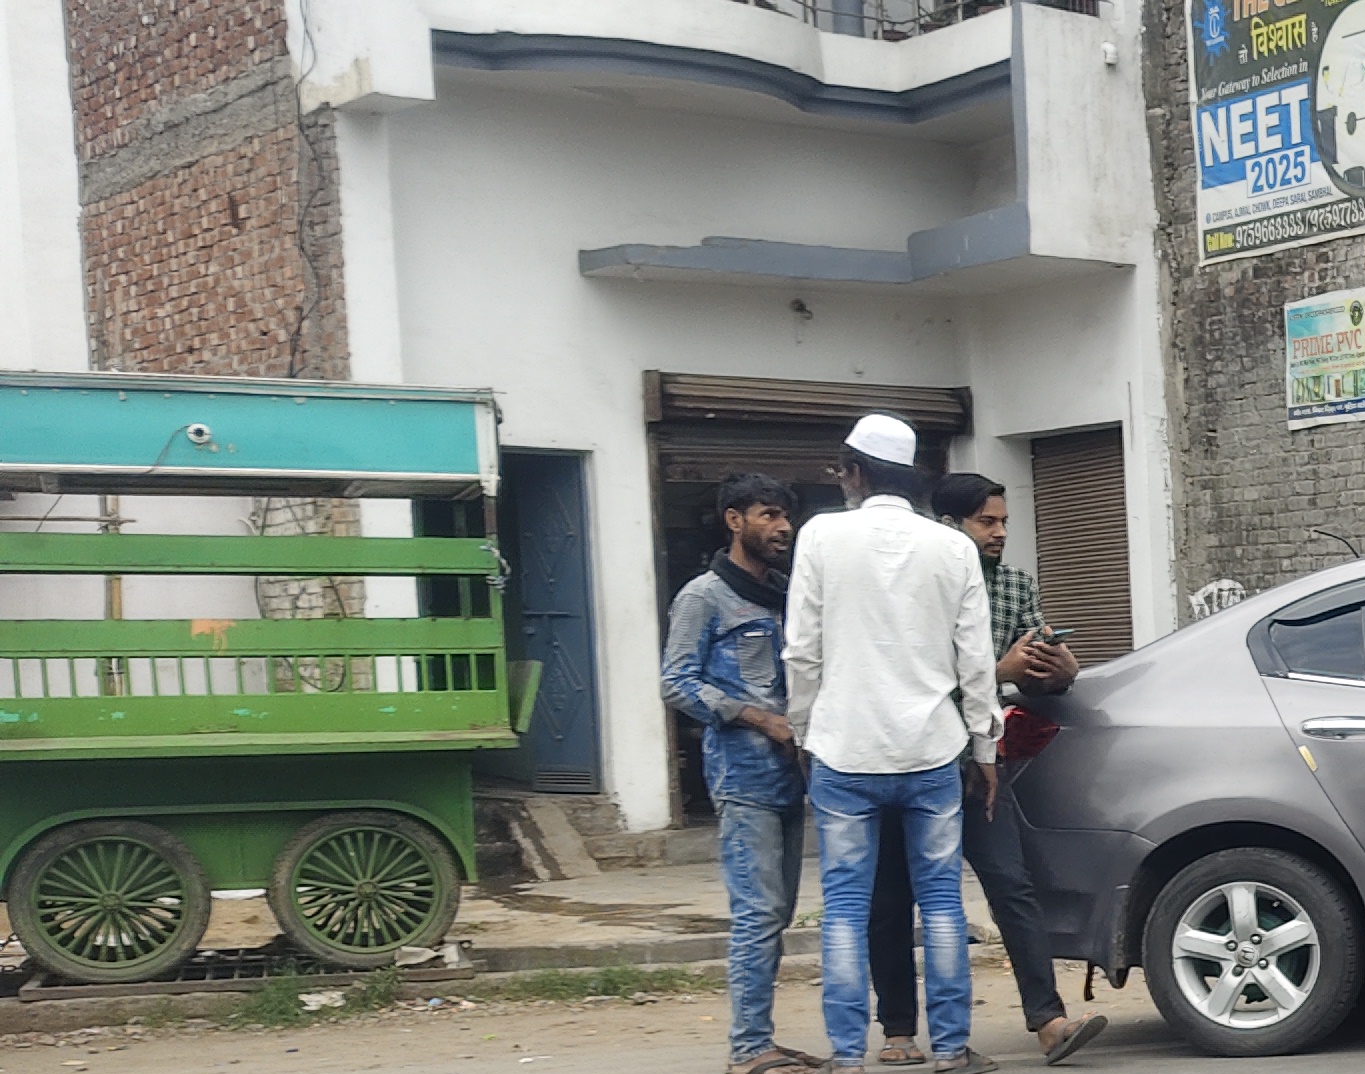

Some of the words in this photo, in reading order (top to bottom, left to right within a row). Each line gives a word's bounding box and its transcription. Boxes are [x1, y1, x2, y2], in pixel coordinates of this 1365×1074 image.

[1250, 13, 1307, 60] विश्वास
[1218, 77, 1251, 97] Gateway
[1252, 74, 1261, 87] to
[1261, 61, 1298, 85] Selection
[1299, 57, 1308, 73] in
[1201, 83, 1309, 167] NEET
[1251, 150, 1306, 193] 2025
[1292, 333, 1334, 359] PRIME
[1336, 328, 1363, 352] PVC
